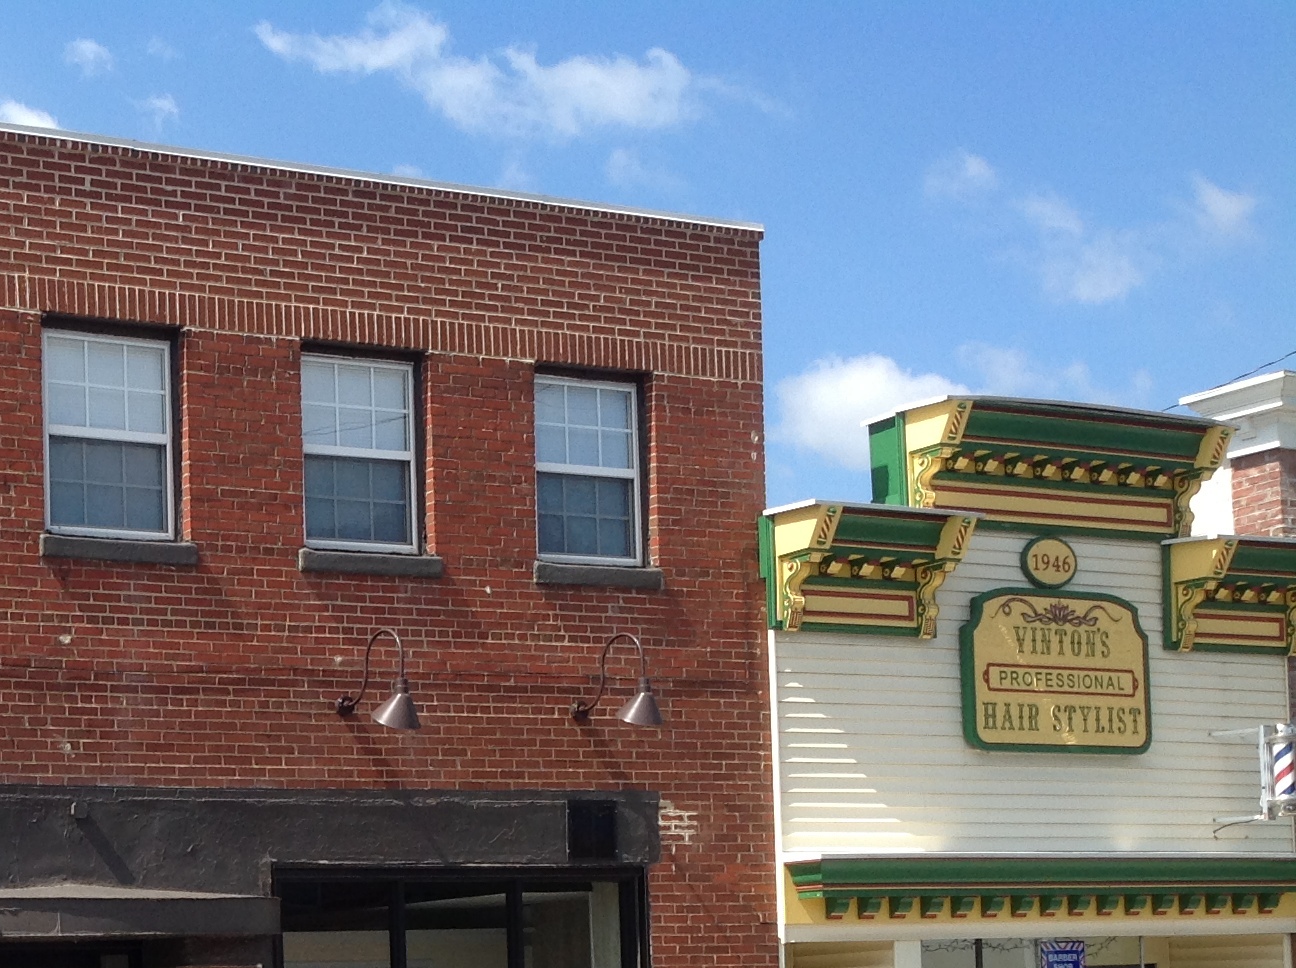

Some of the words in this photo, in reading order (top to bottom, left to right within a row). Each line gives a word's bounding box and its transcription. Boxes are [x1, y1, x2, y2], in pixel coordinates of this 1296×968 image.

[1032, 553, 1072, 573] 1946
[1013, 625, 1111, 659] VINTON'S
[998, 669, 1126, 692] PROFESSIONAL
[982, 701, 1041, 732] HAIR
[1050, 704, 1142, 735] STYLIST
[1048, 953, 1078, 963] BARBER
